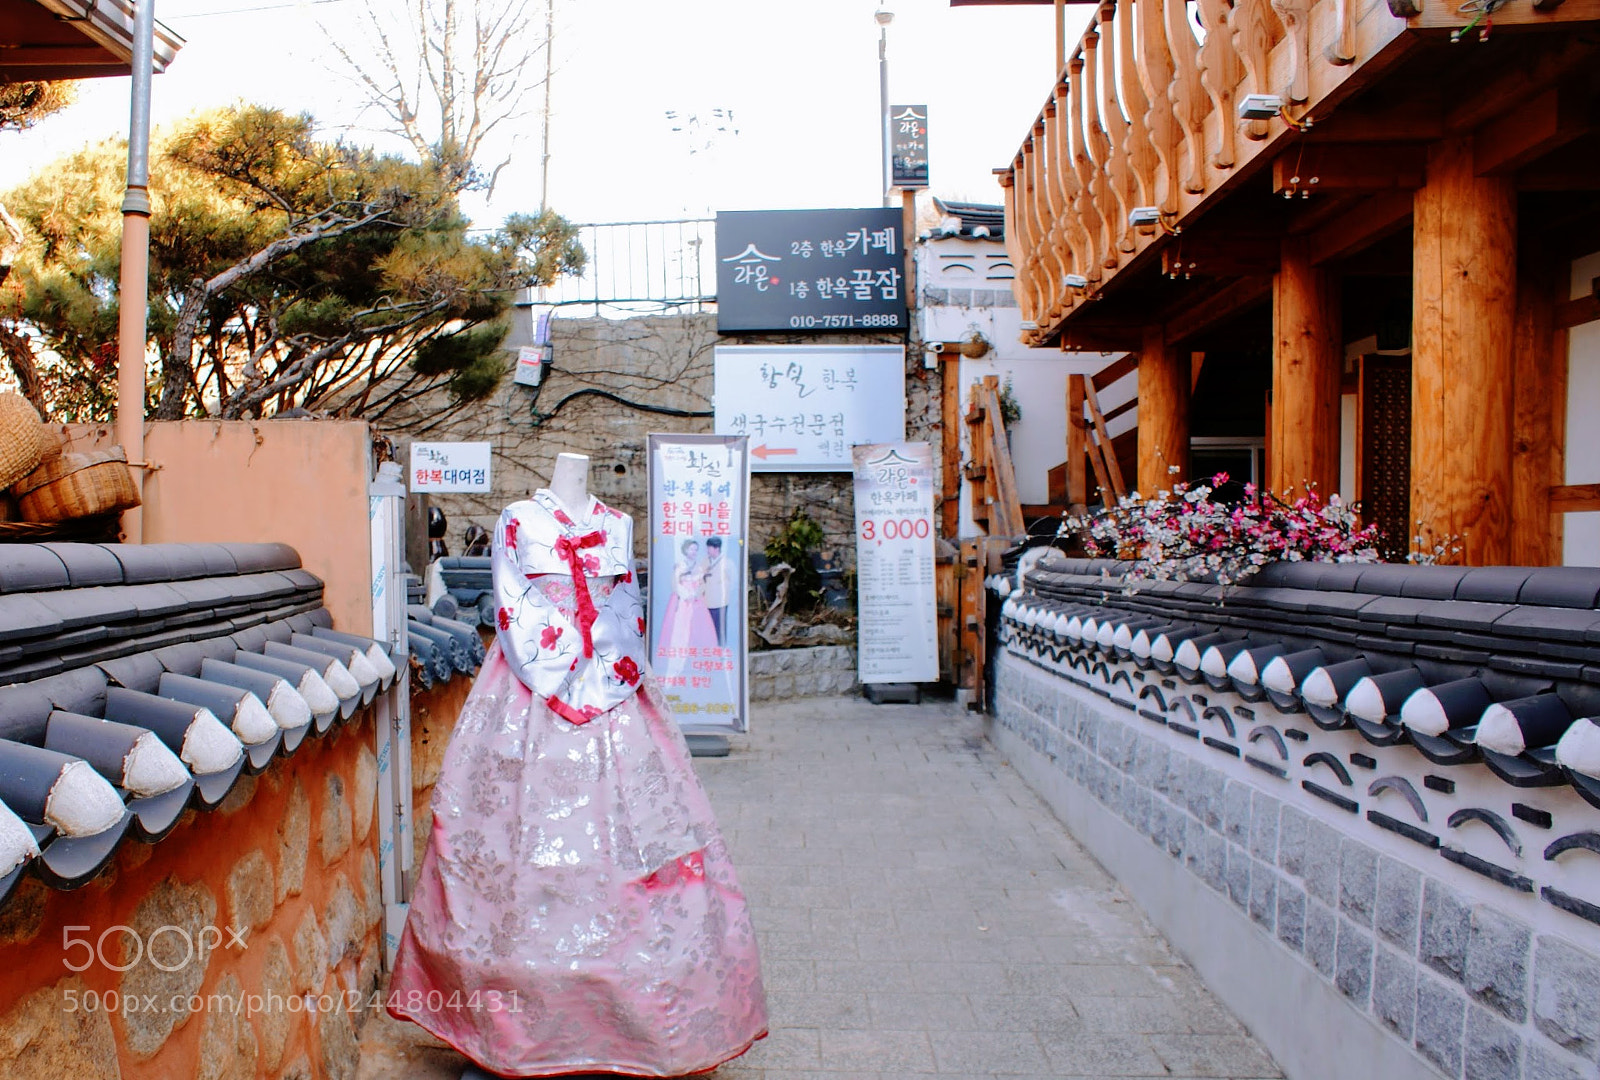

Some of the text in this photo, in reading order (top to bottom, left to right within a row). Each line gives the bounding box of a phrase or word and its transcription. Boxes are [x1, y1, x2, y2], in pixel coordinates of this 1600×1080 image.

[791, 240, 814, 258] 2층
[790, 280, 810, 299] 1층
[790, 314, 899, 328] 010-7571-8888
[822, 368, 858, 391] 한복
[416, 469, 485, 485] 한복대여점
[662, 501, 731, 519] 한옥마을
[862, 518, 929, 546] 3,000
